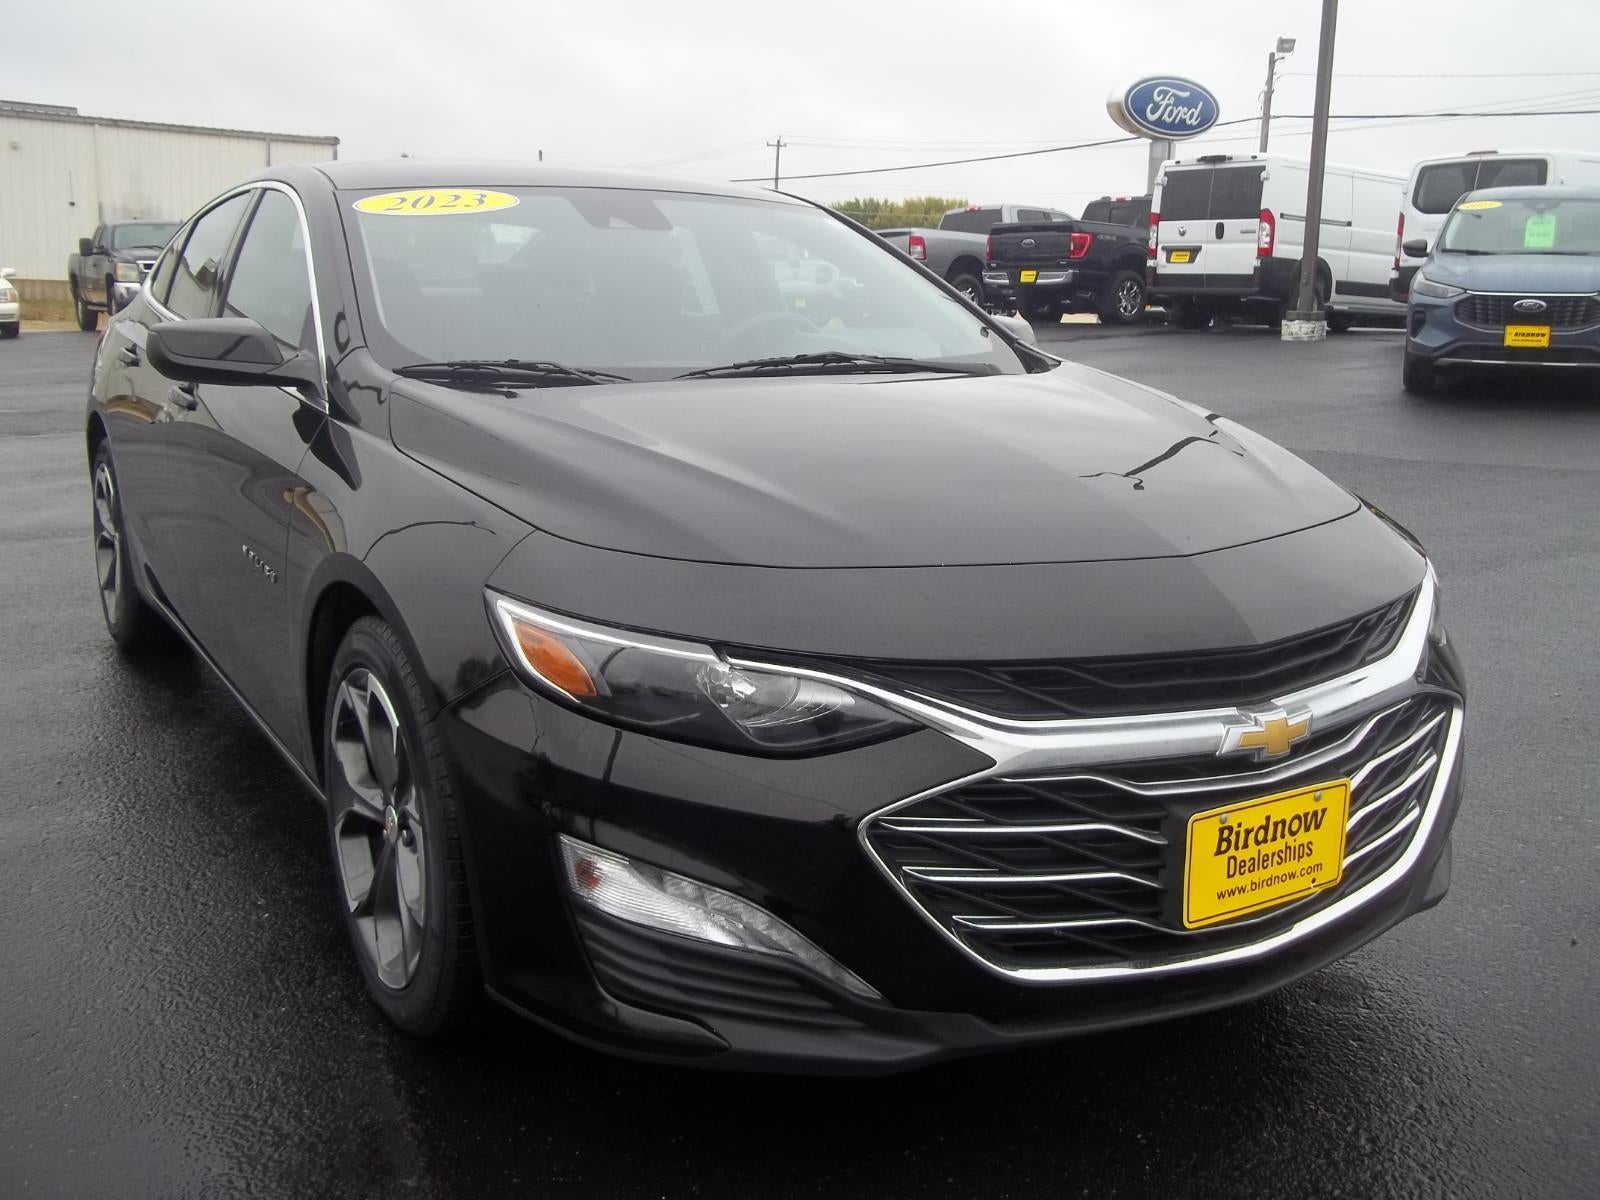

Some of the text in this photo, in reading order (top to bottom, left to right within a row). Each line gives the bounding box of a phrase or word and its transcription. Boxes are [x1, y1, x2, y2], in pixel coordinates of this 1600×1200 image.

[1146, 86, 1203, 126] Ford
[384, 193, 487, 211] 2023
[1213, 807, 1328, 857] Birdnow
[1226, 839, 1314, 879] Dealerships
[1216, 862, 1323, 900] www.birdnow.com
